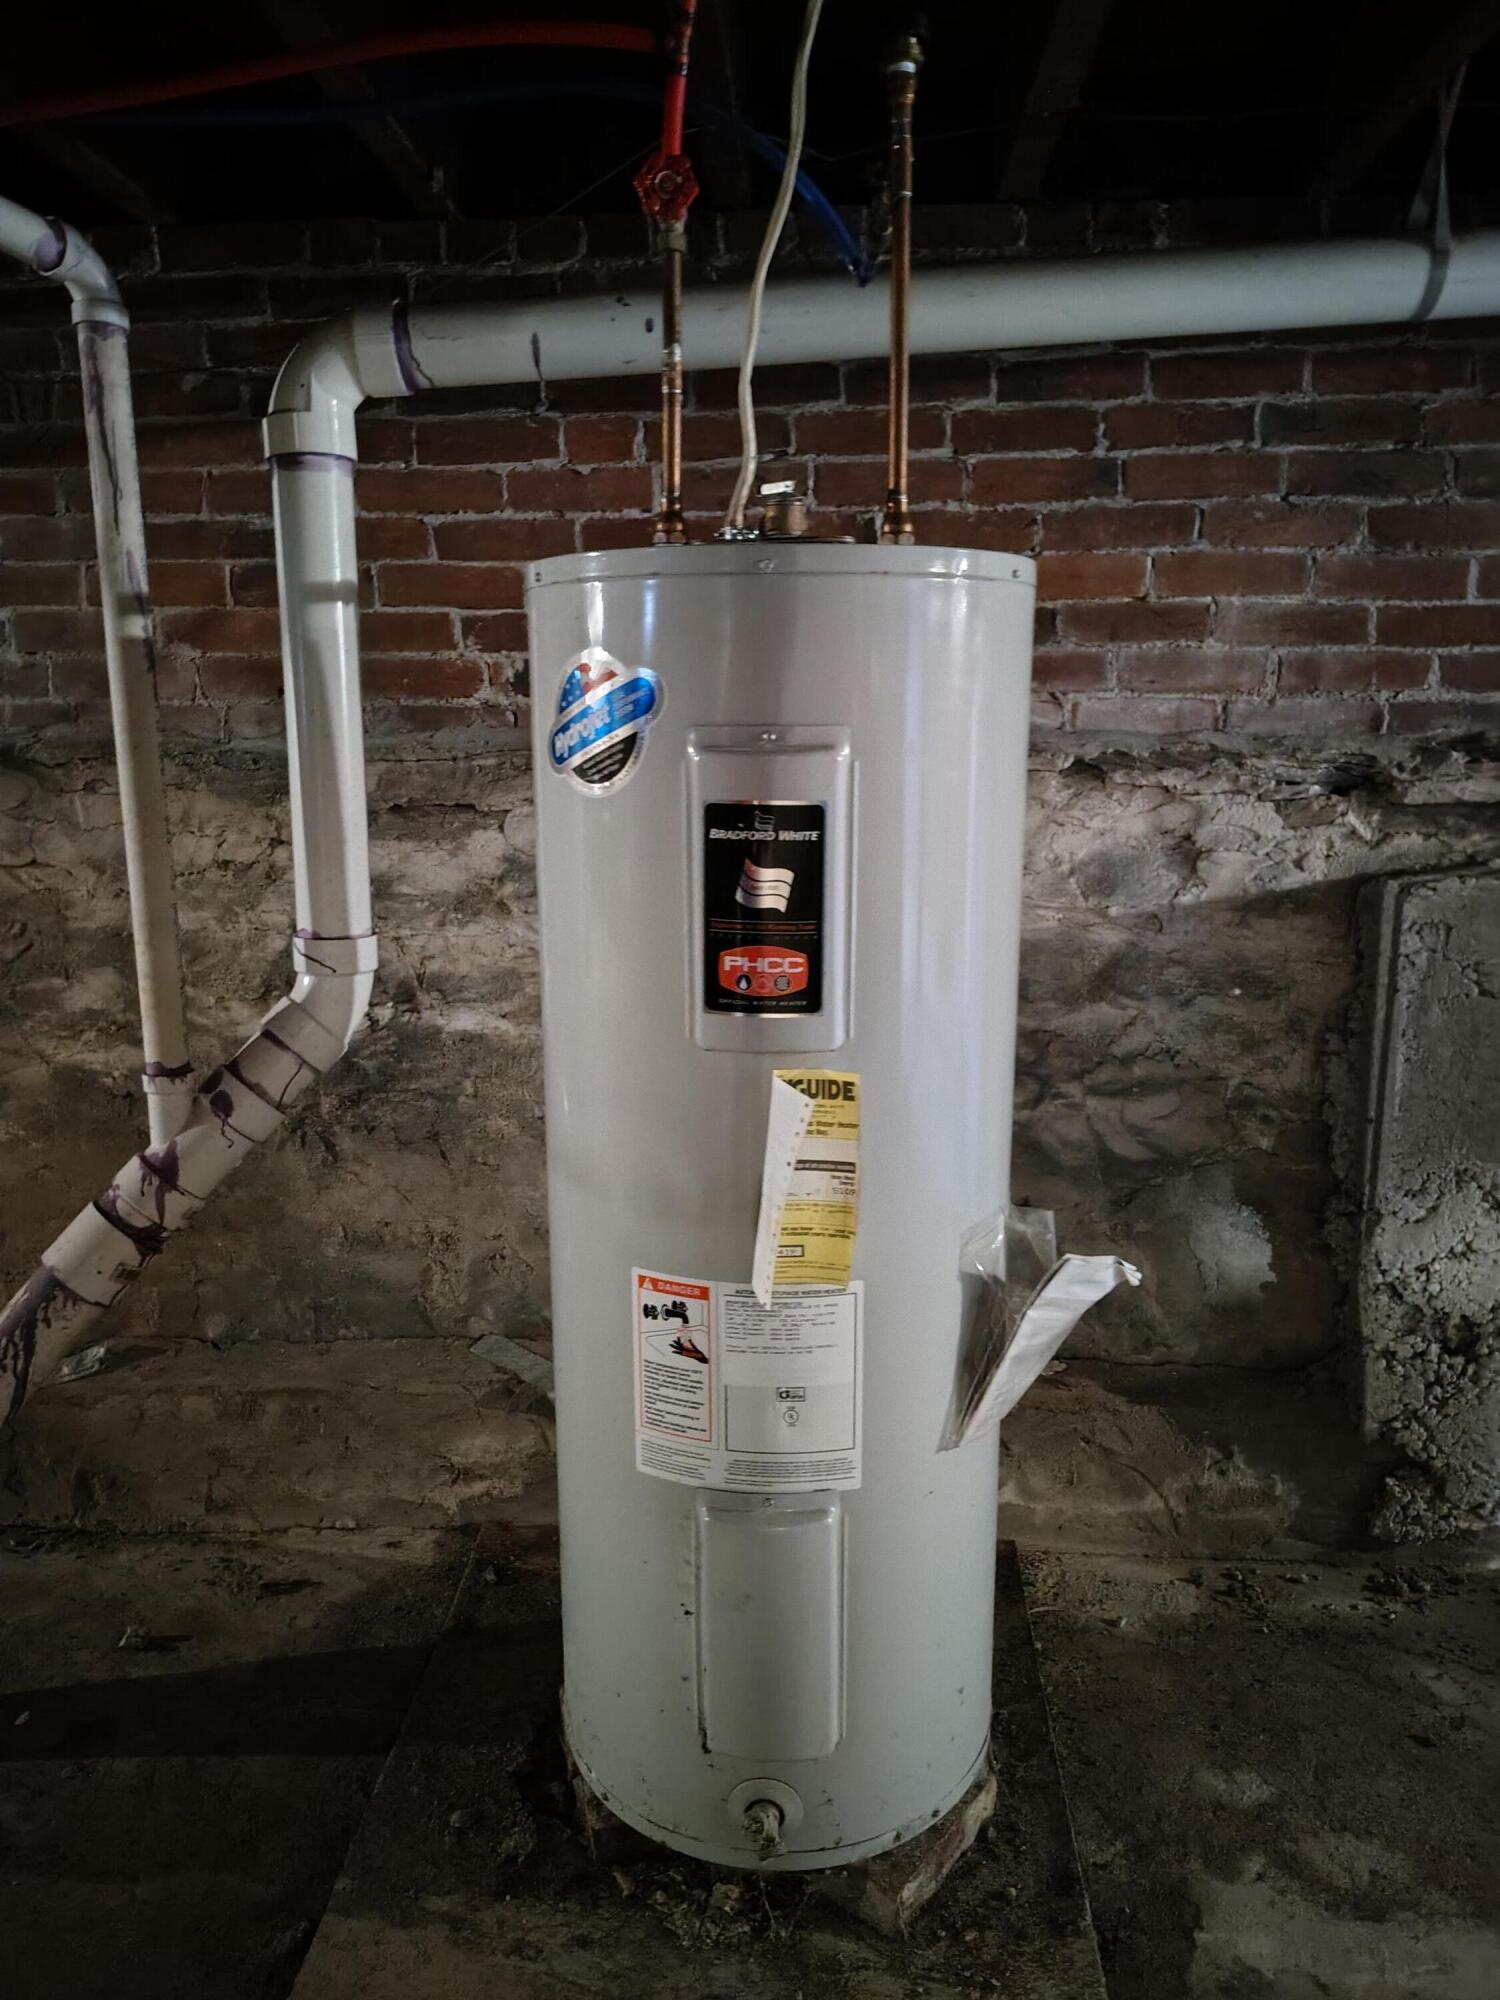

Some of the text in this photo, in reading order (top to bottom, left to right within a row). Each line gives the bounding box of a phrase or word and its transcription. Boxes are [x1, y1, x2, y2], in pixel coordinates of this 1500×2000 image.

[709, 829, 821, 841] BRADFORD WHITE
[724, 956, 806, 974] PHCC
[657, 1281, 701, 1295] DANGER
